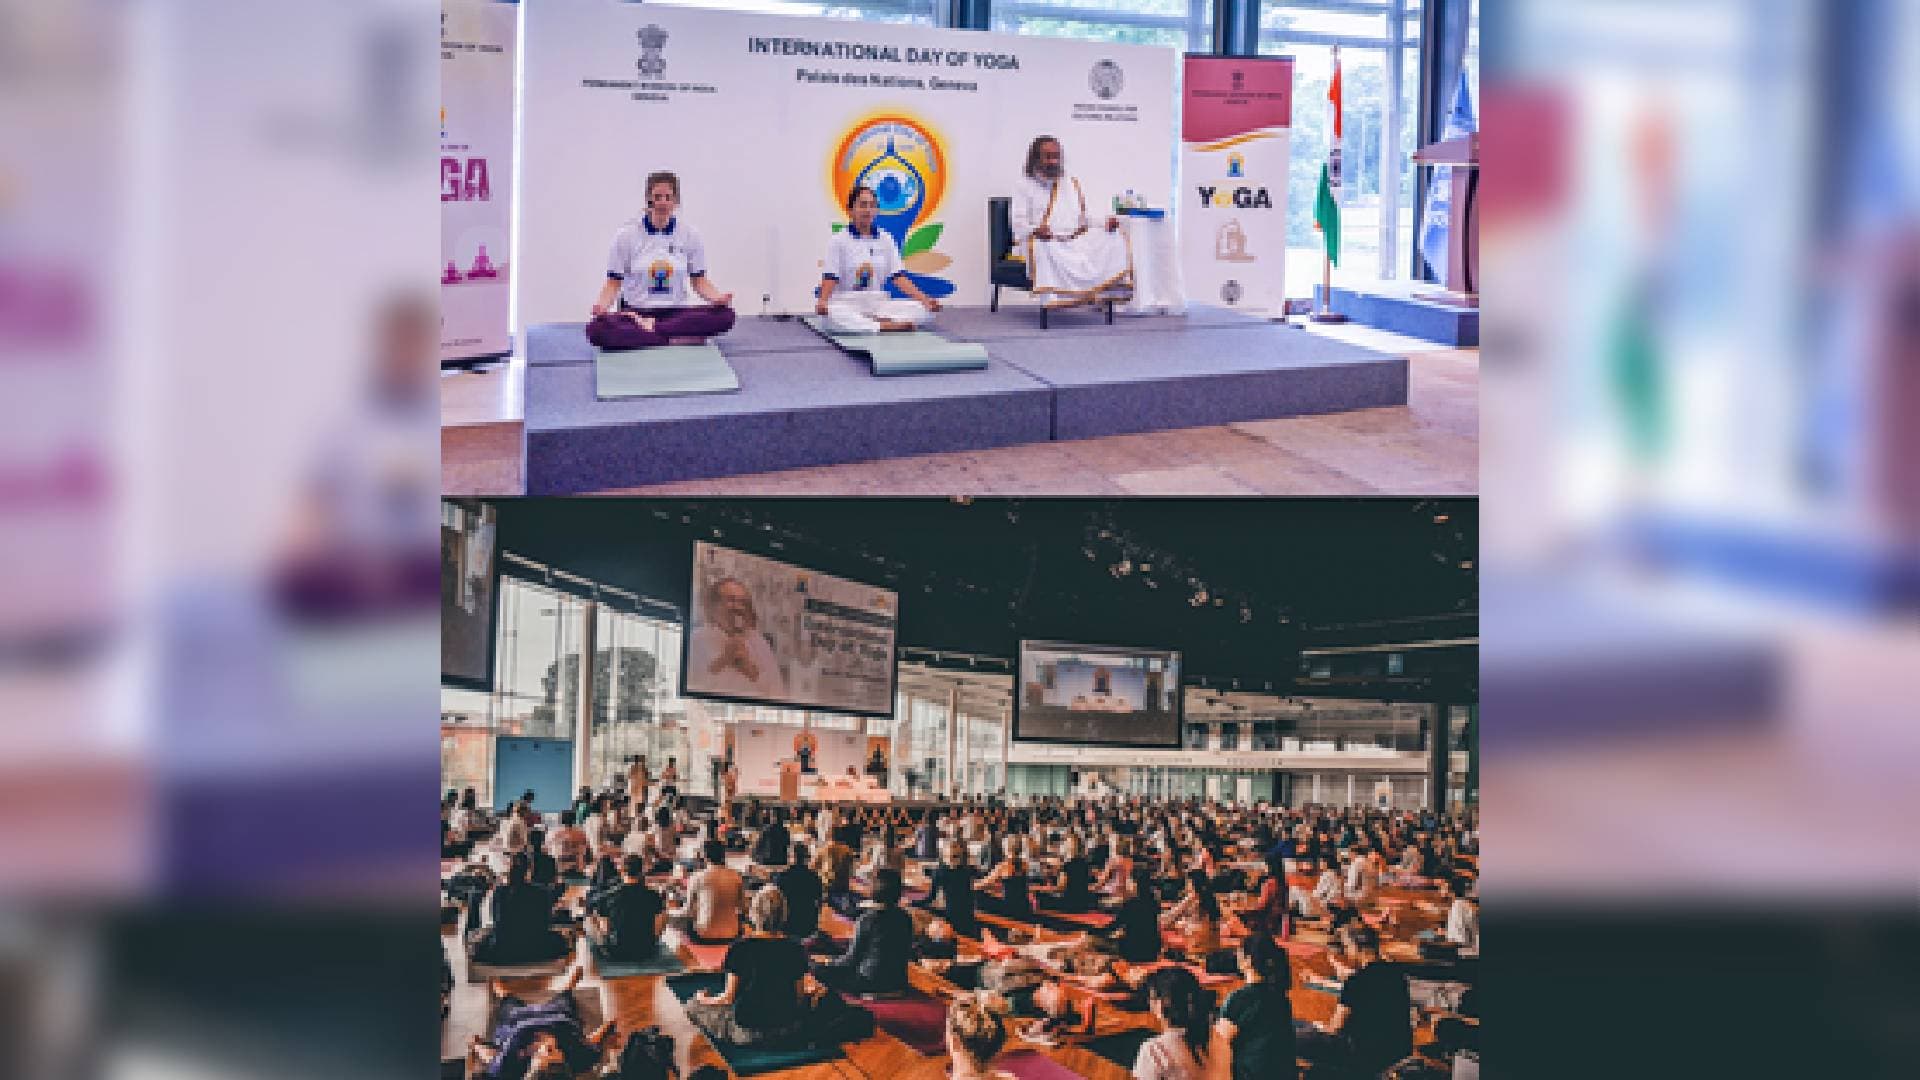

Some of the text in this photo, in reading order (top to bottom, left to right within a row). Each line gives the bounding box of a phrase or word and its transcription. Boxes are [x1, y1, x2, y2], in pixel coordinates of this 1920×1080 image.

[748, 38, 1020, 71] INTERNATIONAL DAY OF YOGA
[796, 68, 840, 84] Palais
[843, 72, 868, 86] des
[929, 76, 978, 92] Geneva
[1198, 186, 1273, 209] YOGA
